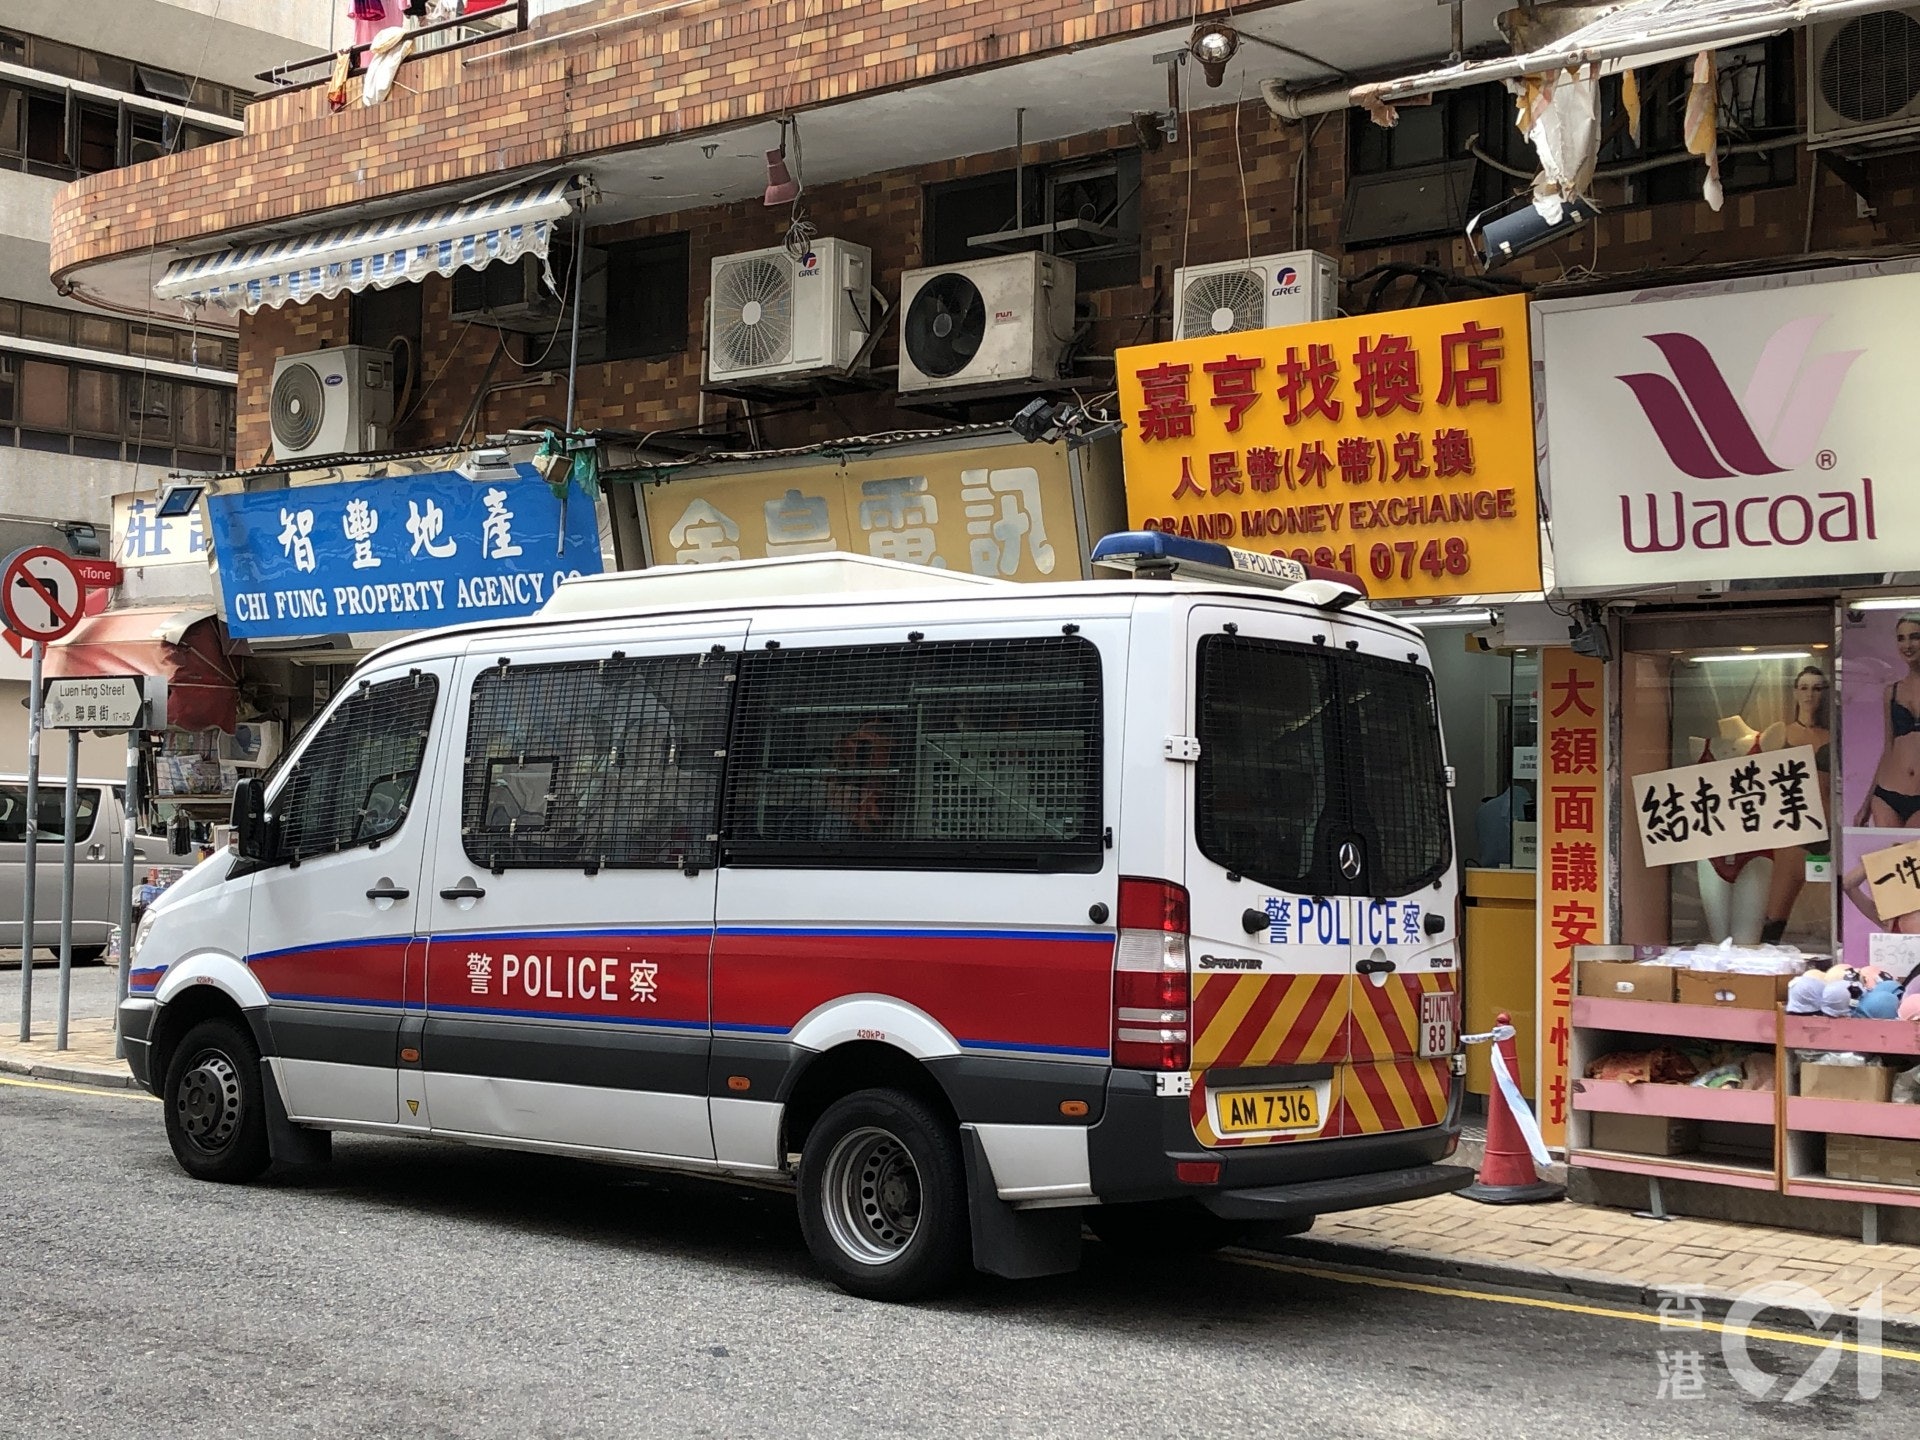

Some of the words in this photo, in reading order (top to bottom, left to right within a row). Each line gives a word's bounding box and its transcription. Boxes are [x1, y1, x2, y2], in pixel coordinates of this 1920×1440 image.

[798, 268, 820, 277] GREE
[1271, 285, 1302, 296] GREE
[1136, 321, 1505, 443] 嘉亨找換店
[1241, 501, 1345, 538] MONEY
[1349, 488, 1517, 530] EXCHANGE
[277, 487, 523, 574] 智豐地產
[1248, 553, 1289, 578] POLICE
[1369, 537, 1470, 580] 0748
[235, 592, 271, 621] CHI
[274, 588, 328, 618] FUNG
[333, 580, 445, 616] PROPERTY
[457, 572, 544, 608] AGENCY
[60, 685, 79, 697] Luen
[80, 685, 98, 699] Hing
[99, 684, 126, 696] Street
[75, 705, 109, 721] 聯興街
[1642, 760, 1823, 844] 結束營業
[1265, 896, 1291, 944] 警
[1298, 897, 1398, 945] POLICE
[1403, 900, 1422, 944] 察
[467, 952, 493, 994] 警
[502, 953, 619, 1001] POLICE
[629, 959, 658, 1003] 察
[1199, 954, 1263, 970] SPRINTER
[857, 1029, 886, 1040] 420kPa
[1429, 1024, 1446, 1052] 88
[1231, 1097, 1257, 1126] AM
[1264, 1095, 1311, 1124] 7316
